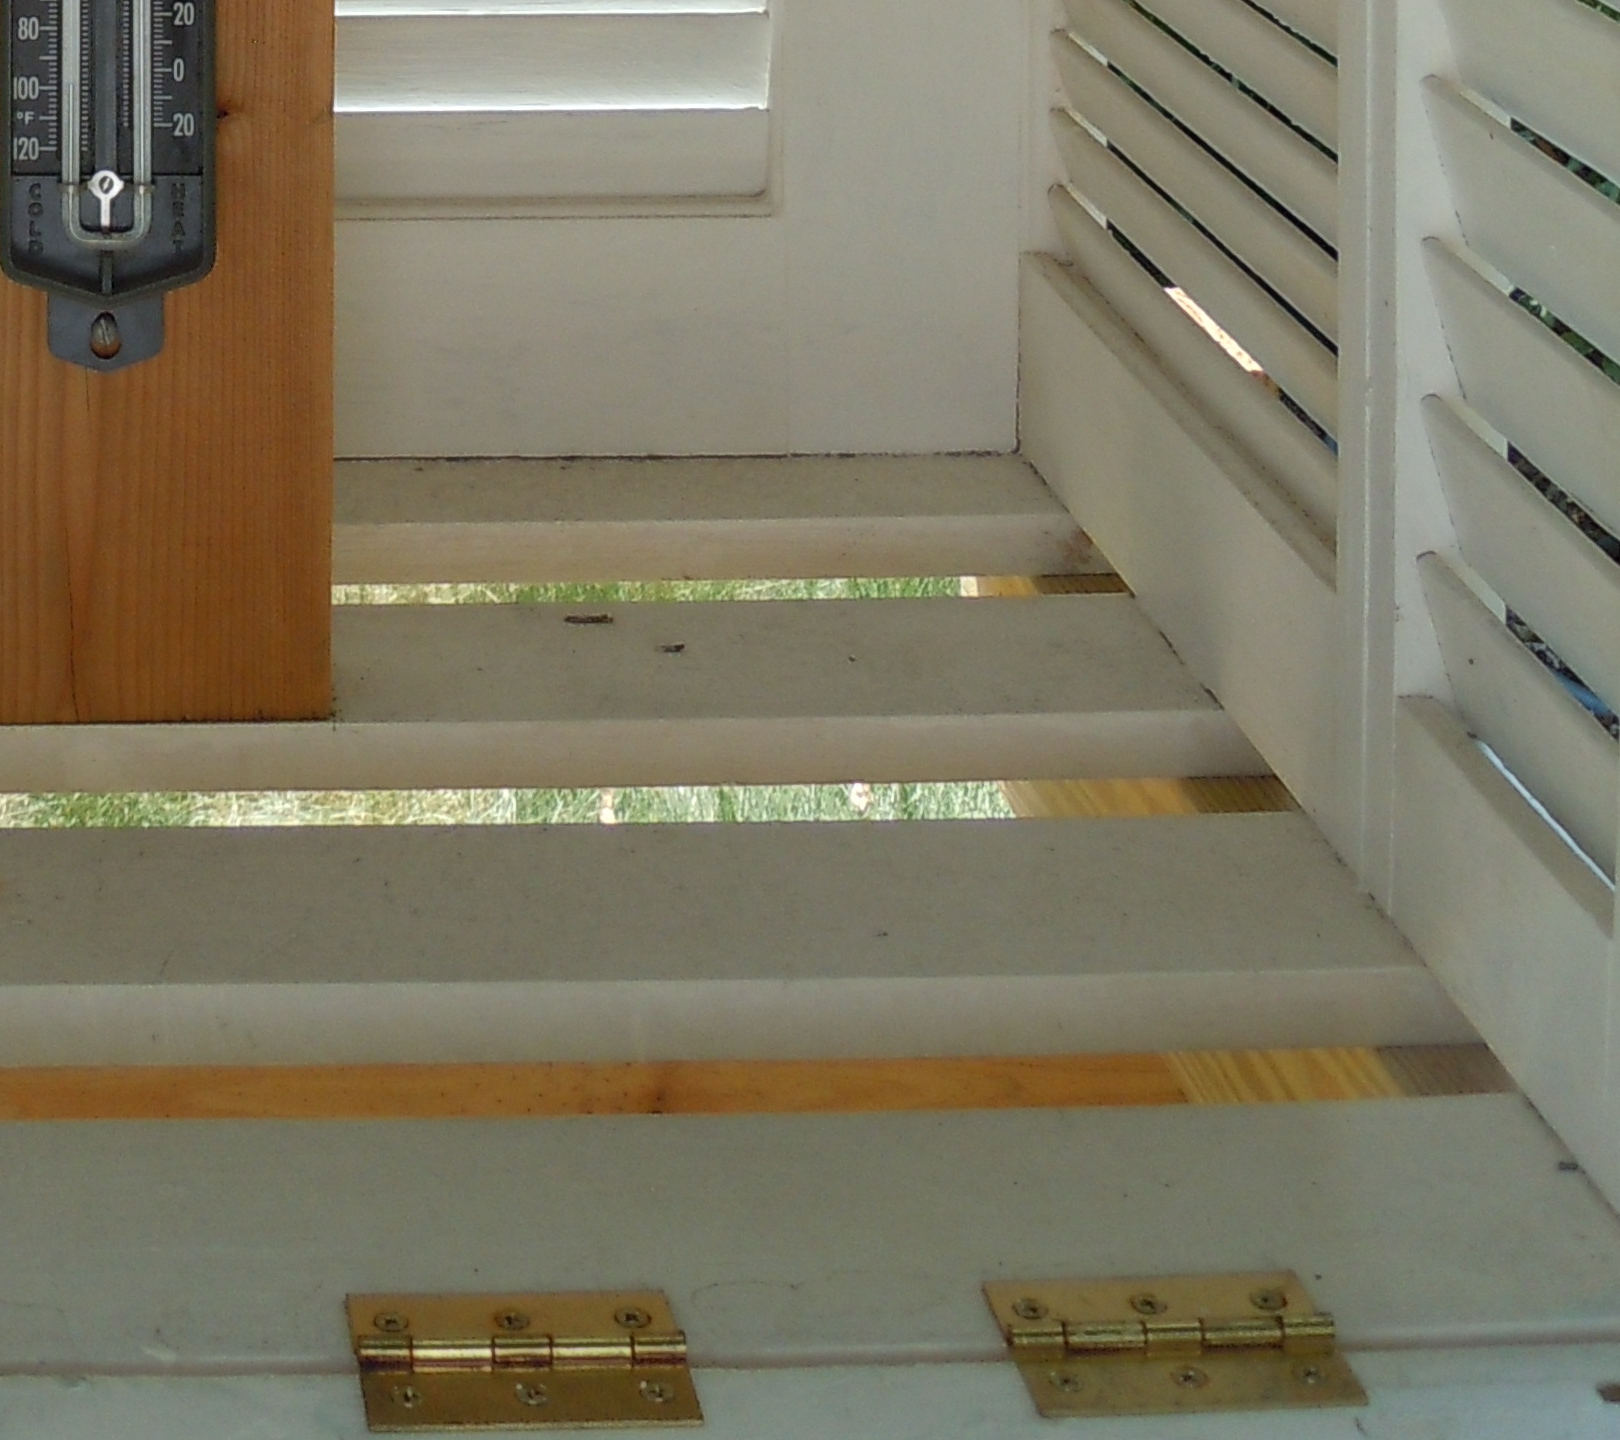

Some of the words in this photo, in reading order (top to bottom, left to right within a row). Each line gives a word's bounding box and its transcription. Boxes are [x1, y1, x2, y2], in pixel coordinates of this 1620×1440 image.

[173, 2, 195, 26] 20
[18, 17, 40, 40] 80
[173, 58, 184, 82] 0
[13, 77, 39, 100] 100
[173, 113, 195, 136] 20
[13, 138, 39, 161] 120
